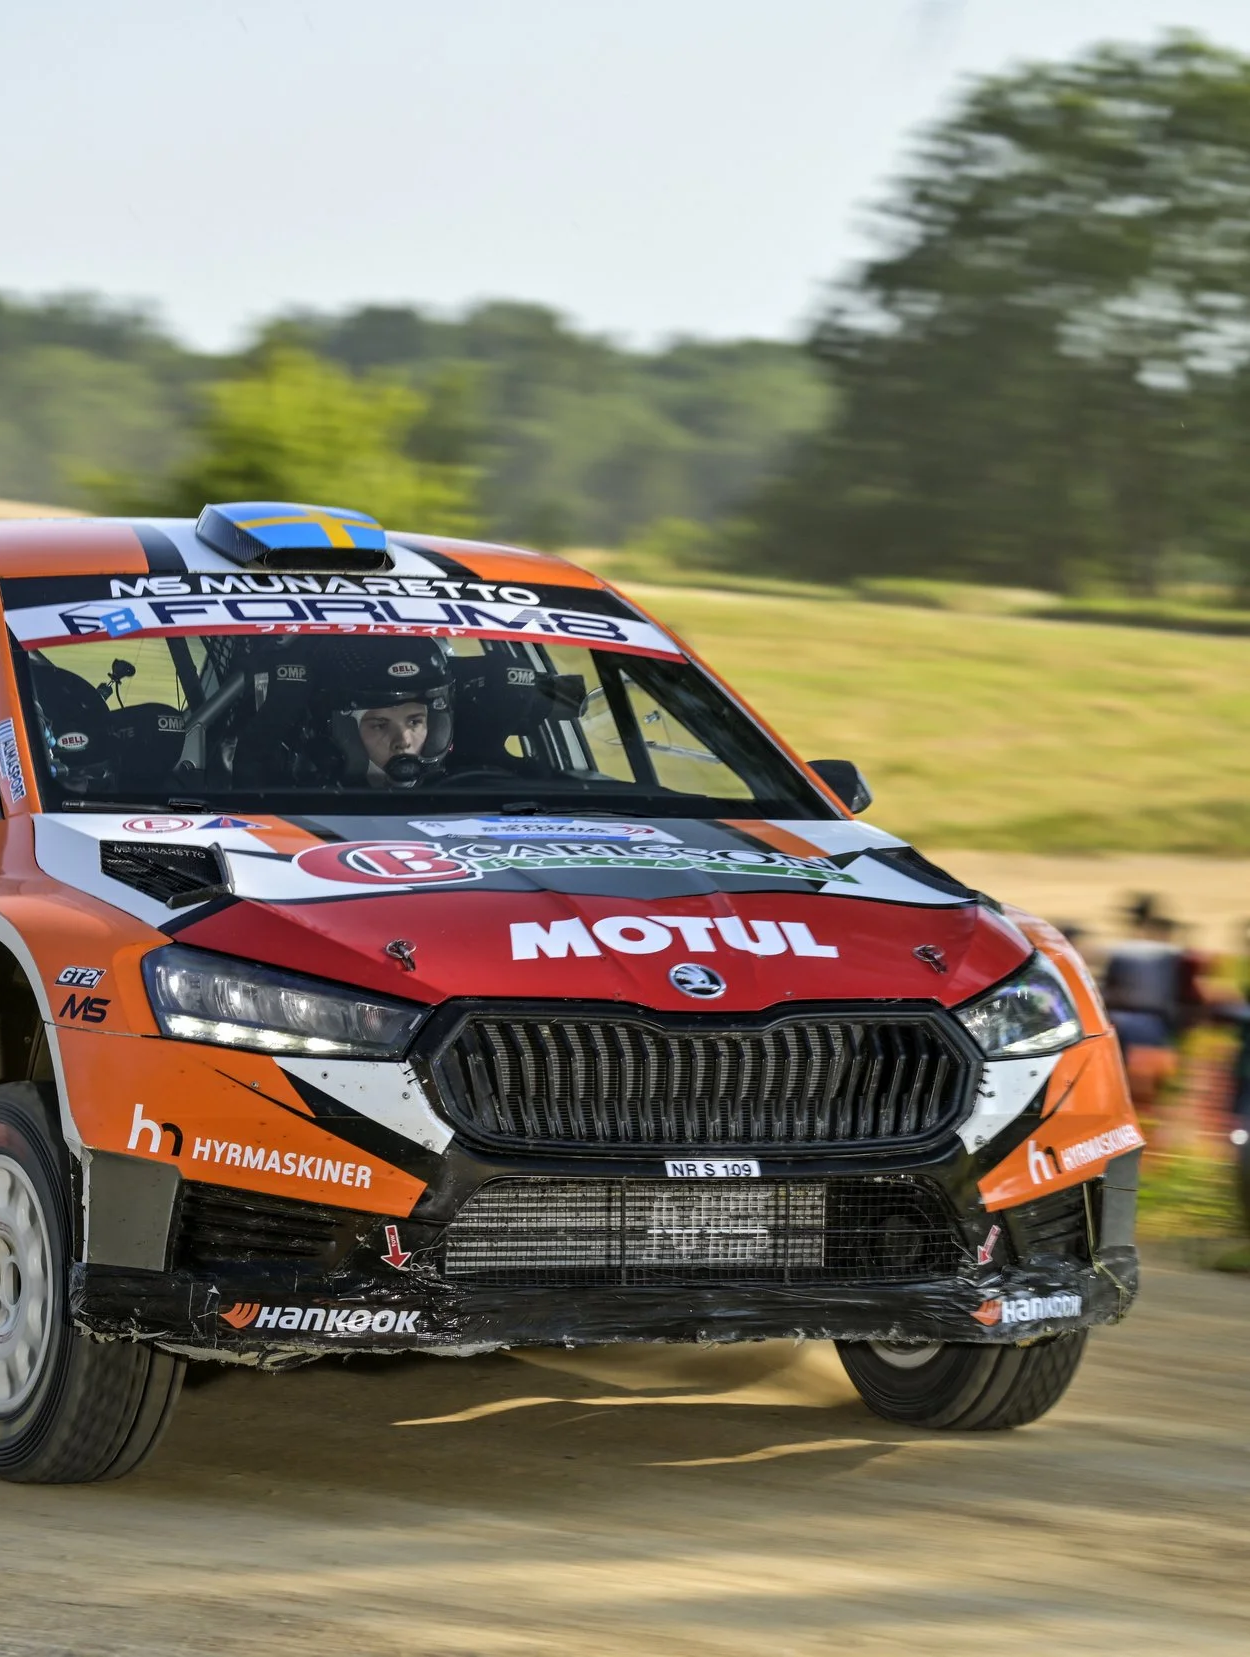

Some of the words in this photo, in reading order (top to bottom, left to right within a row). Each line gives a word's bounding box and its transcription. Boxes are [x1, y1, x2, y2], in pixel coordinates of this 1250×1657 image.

[110, 576, 191, 598] MS
[199, 574, 541, 606] MUNARETTO
[147, 599, 629, 643] FORUM8
[276, 666, 306, 679] OMP
[392, 664, 416, 674] BELL
[61, 735, 86, 745] BELL
[2, 738, 25, 802] ALMASPORT
[450, 843, 842, 872] CARLSSON
[510, 915, 839, 960] MOTUL
[59, 993, 111, 1023] MS
[191, 1137, 372, 1189] HYRMASKINER
[671, 1163, 700, 1177] NR
[704, 1163, 715, 1177] S
[723, 1163, 752, 1177] 109
